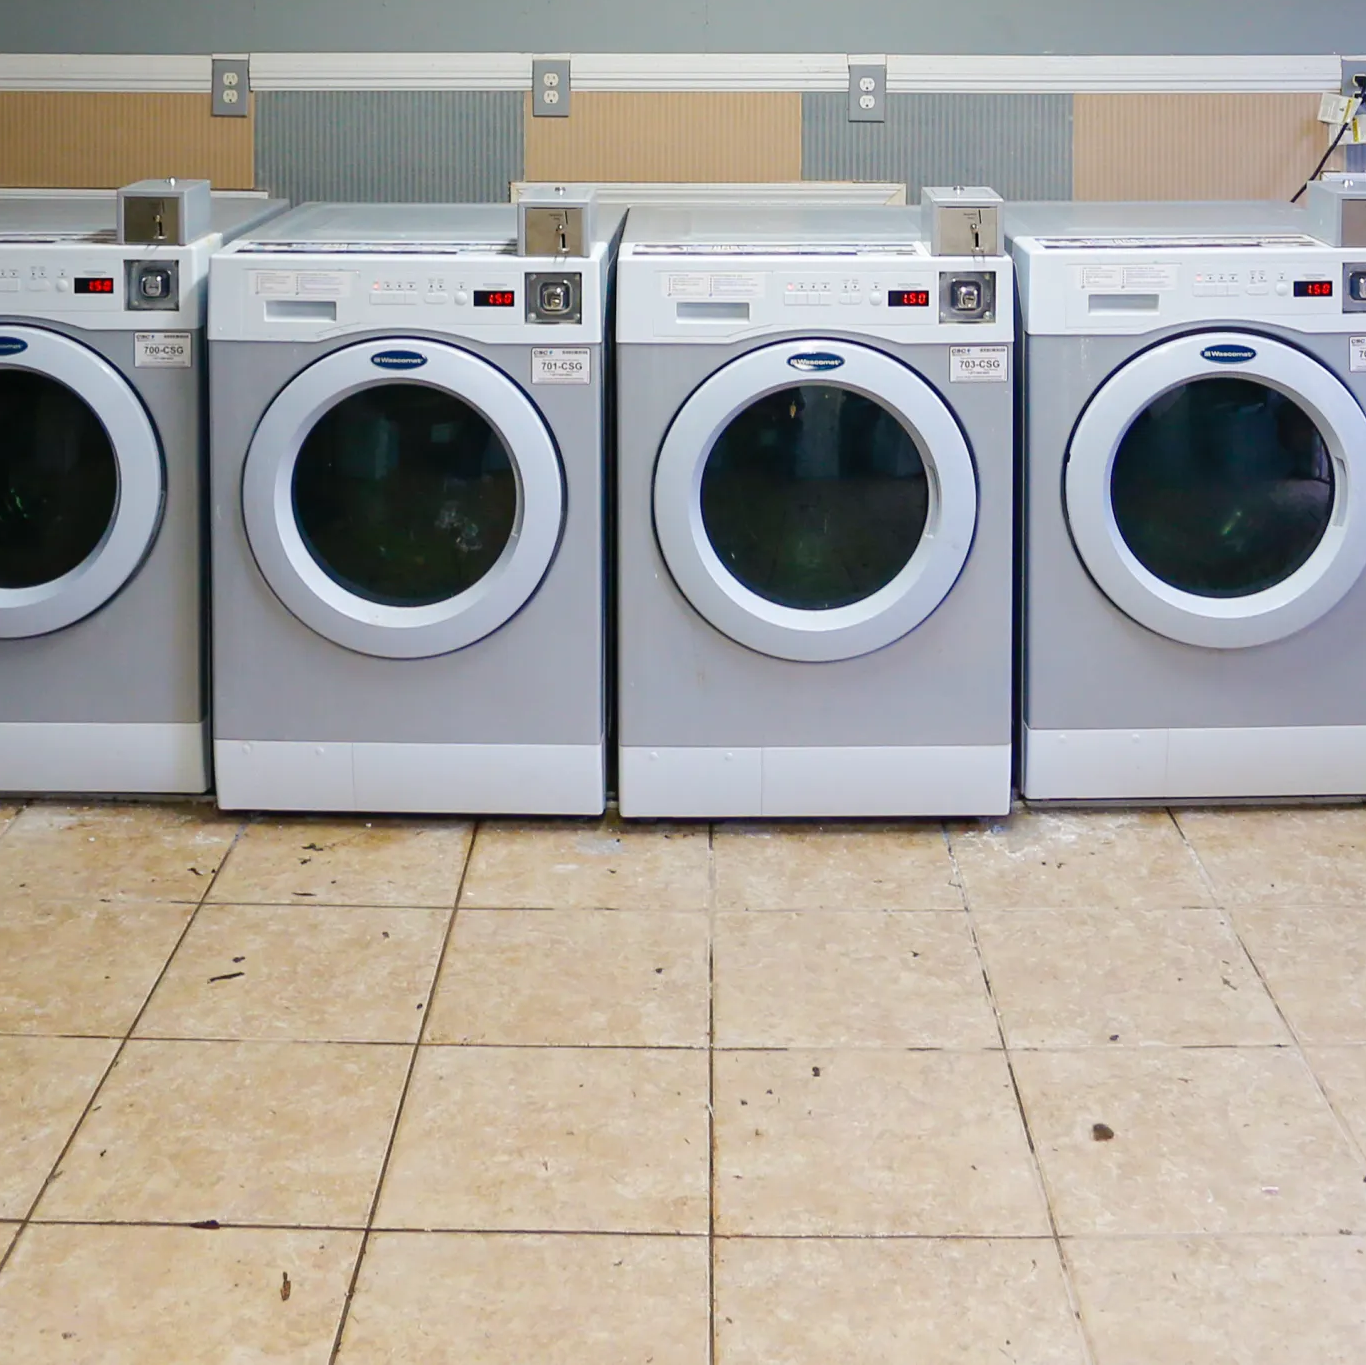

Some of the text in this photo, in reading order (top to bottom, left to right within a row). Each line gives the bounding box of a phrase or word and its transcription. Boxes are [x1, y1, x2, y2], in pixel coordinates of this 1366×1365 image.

[144, 346, 184, 355] 700-CSG
[541, 362, 583, 371] 701-CSG
[959, 360, 1000, 369] 703-CSG
